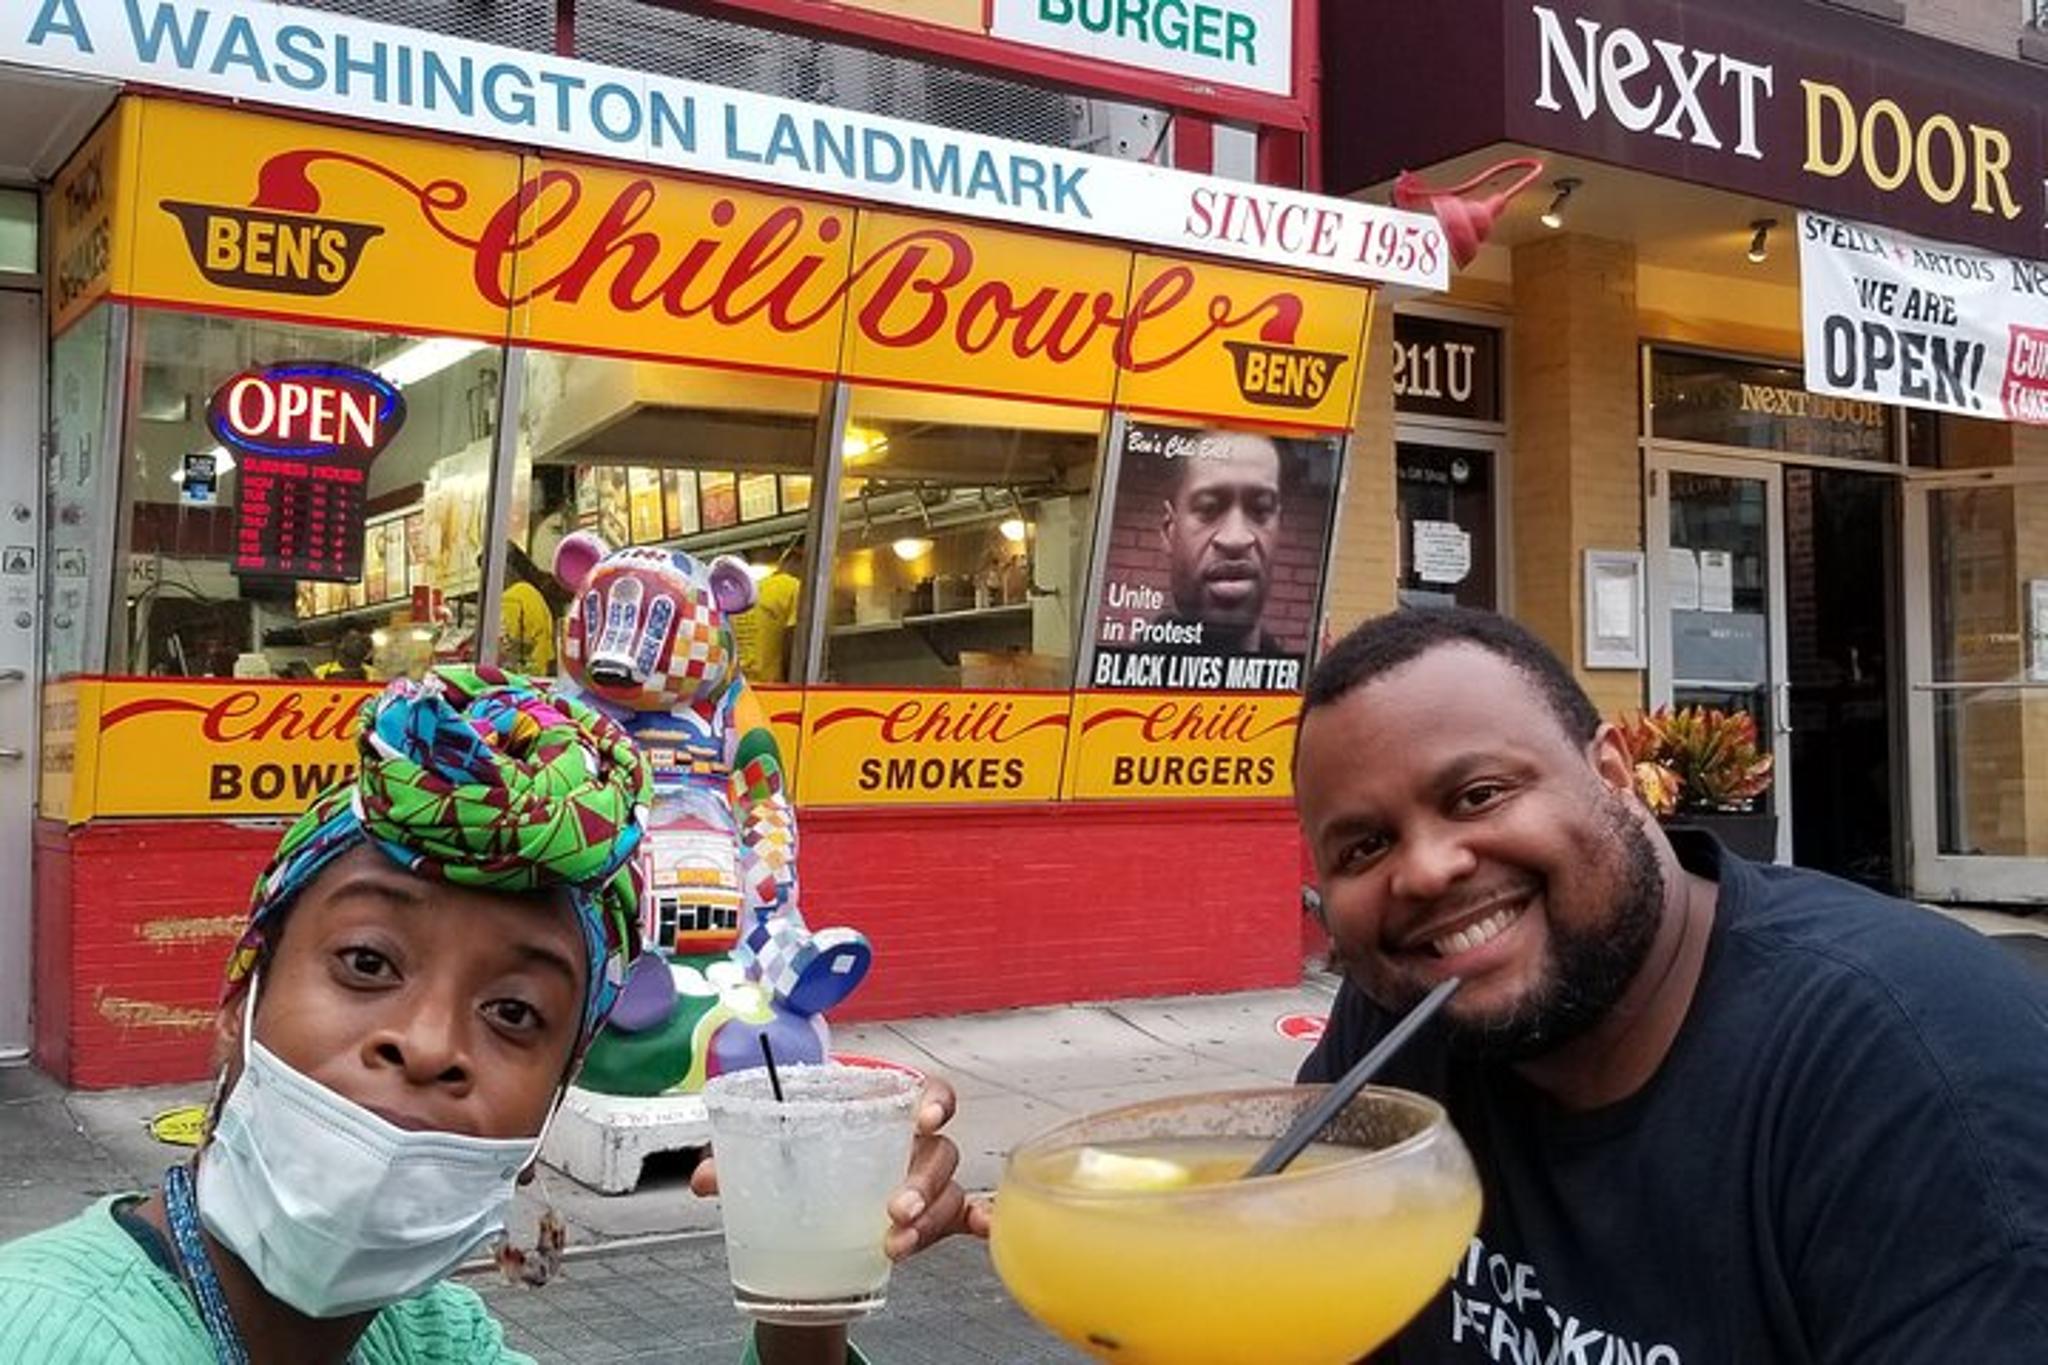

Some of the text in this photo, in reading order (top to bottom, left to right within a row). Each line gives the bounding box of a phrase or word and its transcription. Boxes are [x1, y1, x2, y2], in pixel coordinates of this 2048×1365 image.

[26, 0, 1441, 276] A WASHINGTON LANDMARK SINCE 1958
[1800, 78, 2023, 221] DOOR
[206, 216, 348, 284] BEN'S
[473, 168, 1196, 375] Chili Bowl
[1804, 215, 1996, 283] STELLA ARTOIS
[1853, 276, 1958, 327] WE ARE
[1244, 351, 1327, 400] BEN'S
[1444, 342, 1475, 402] U
[1823, 315, 1987, 411] OPEN!
[228, 377, 377, 449] OPEN
[1108, 581, 1164, 611] Unite
[1102, 616, 1202, 645] in Protest
[1095, 653, 1299, 690] BLACK LIVES MATTER
[202, 690, 374, 743] Chil
[880, 700, 1016, 744] Chili
[1141, 701, 1260, 744] Chili
[209, 763, 355, 801] BOW
[858, 758, 1025, 791] SMOKES
[1113, 755, 1276, 786] BURGERS
